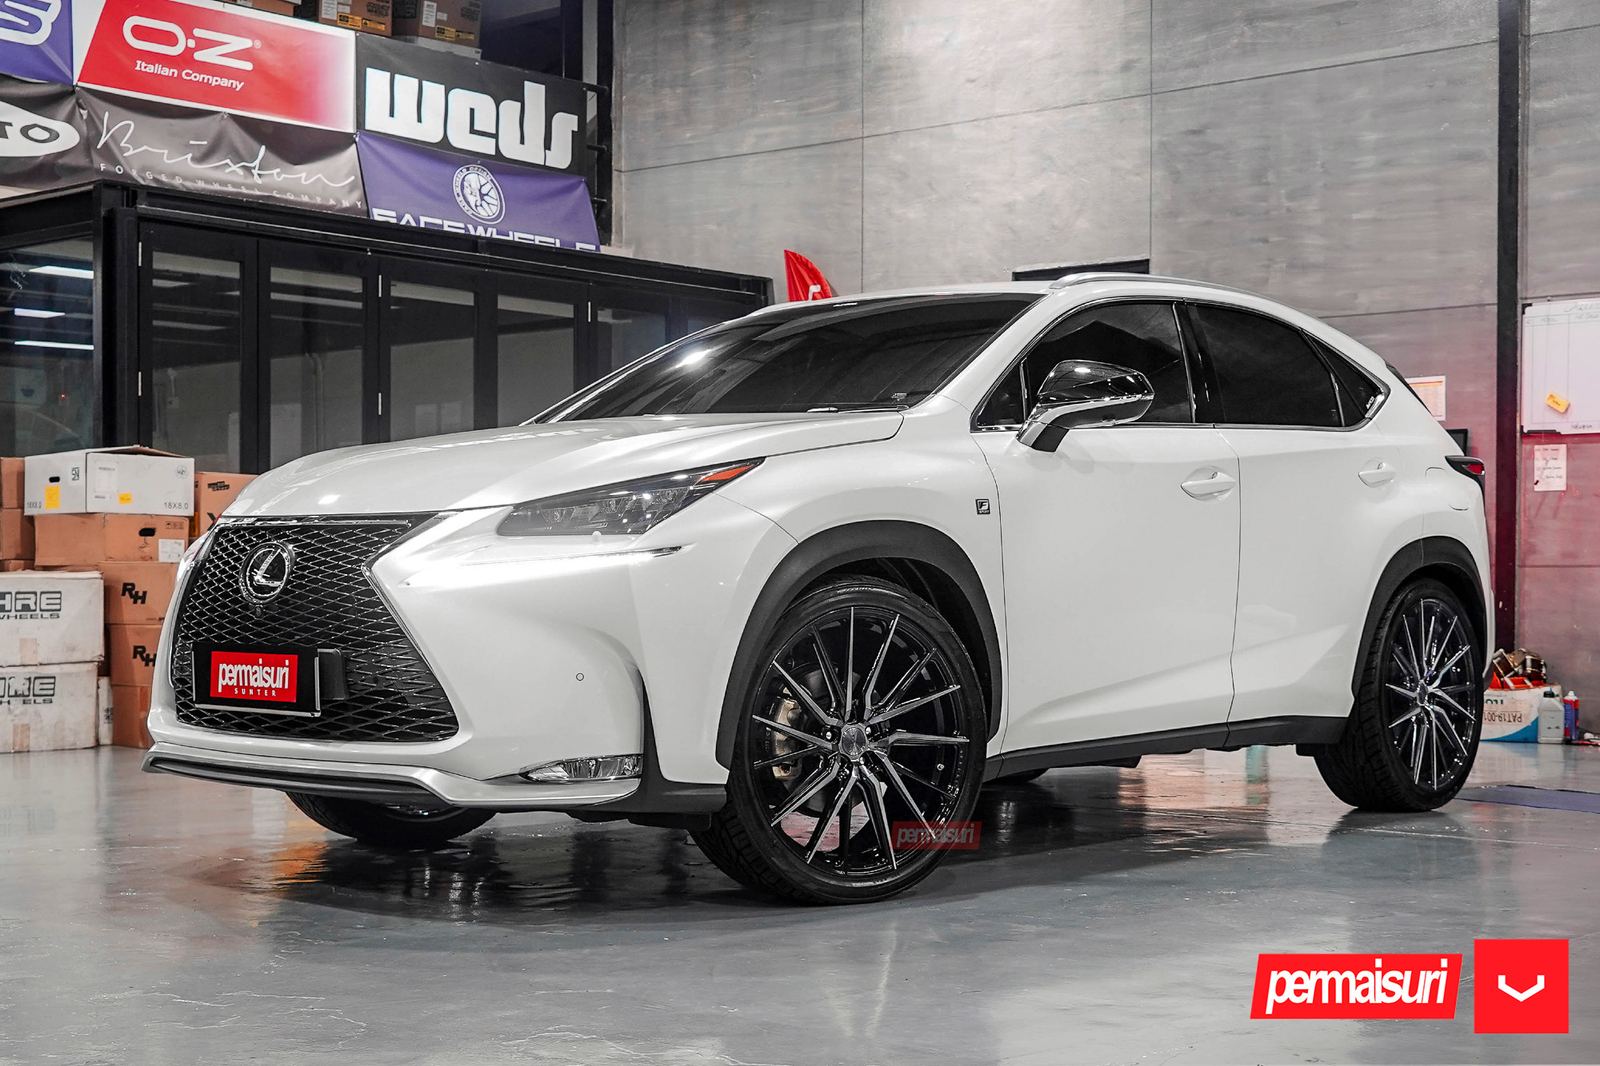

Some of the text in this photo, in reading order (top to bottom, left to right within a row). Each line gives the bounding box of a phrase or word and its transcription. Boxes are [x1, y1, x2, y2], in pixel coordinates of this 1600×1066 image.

[135, 60, 244, 91] Italian Company
[121, 582, 147, 605] RH
[217, 657, 289, 693] permaisuri
[234, 687, 277, 697] SUNTER
